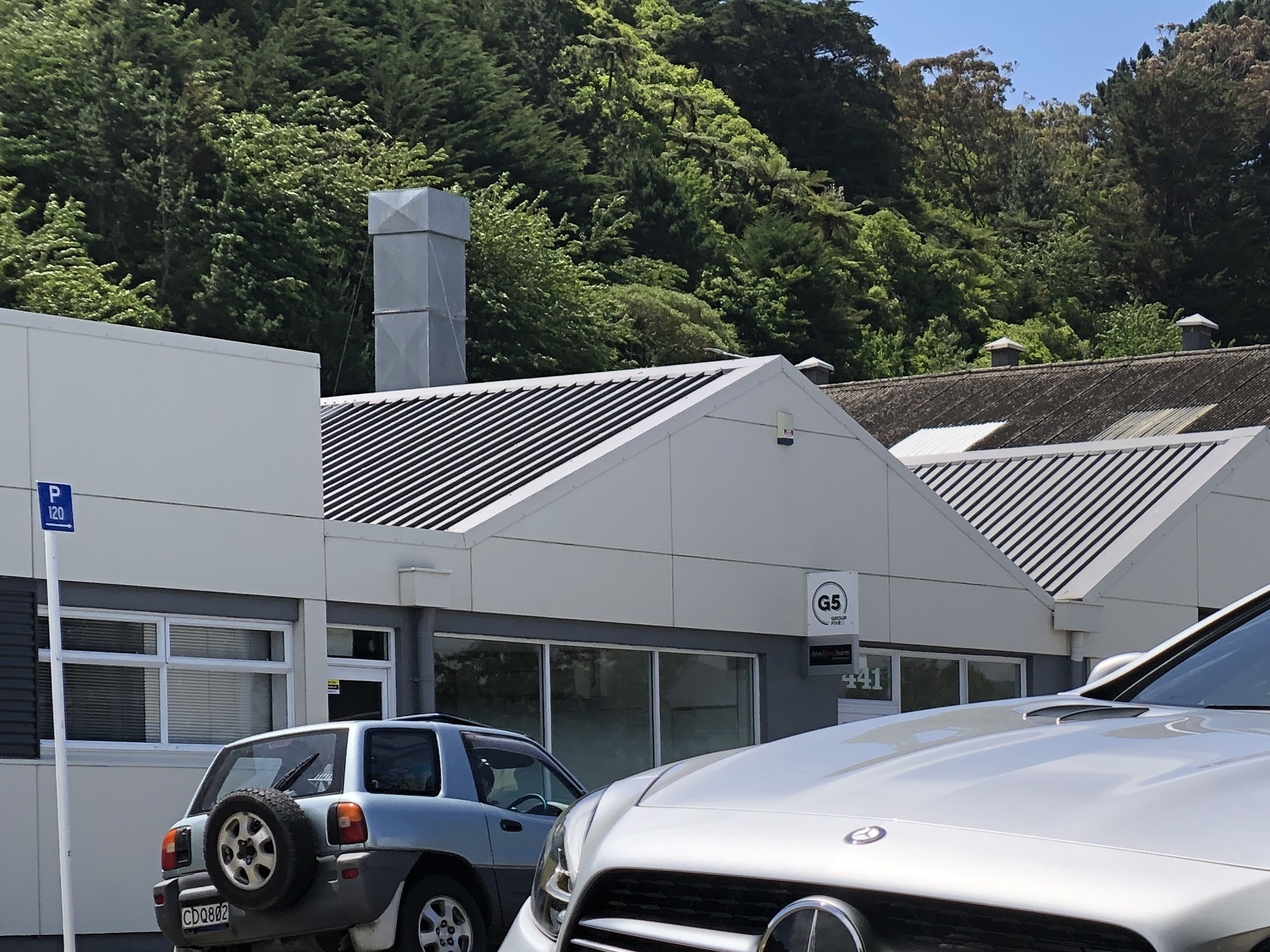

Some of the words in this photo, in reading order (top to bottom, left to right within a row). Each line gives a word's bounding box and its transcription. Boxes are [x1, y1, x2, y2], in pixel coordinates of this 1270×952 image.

[49, 485, 61, 503] P
[48, 505, 65, 521] 120
[817, 594, 841, 612] G5
[183, 904, 229, 926] CDQ802
